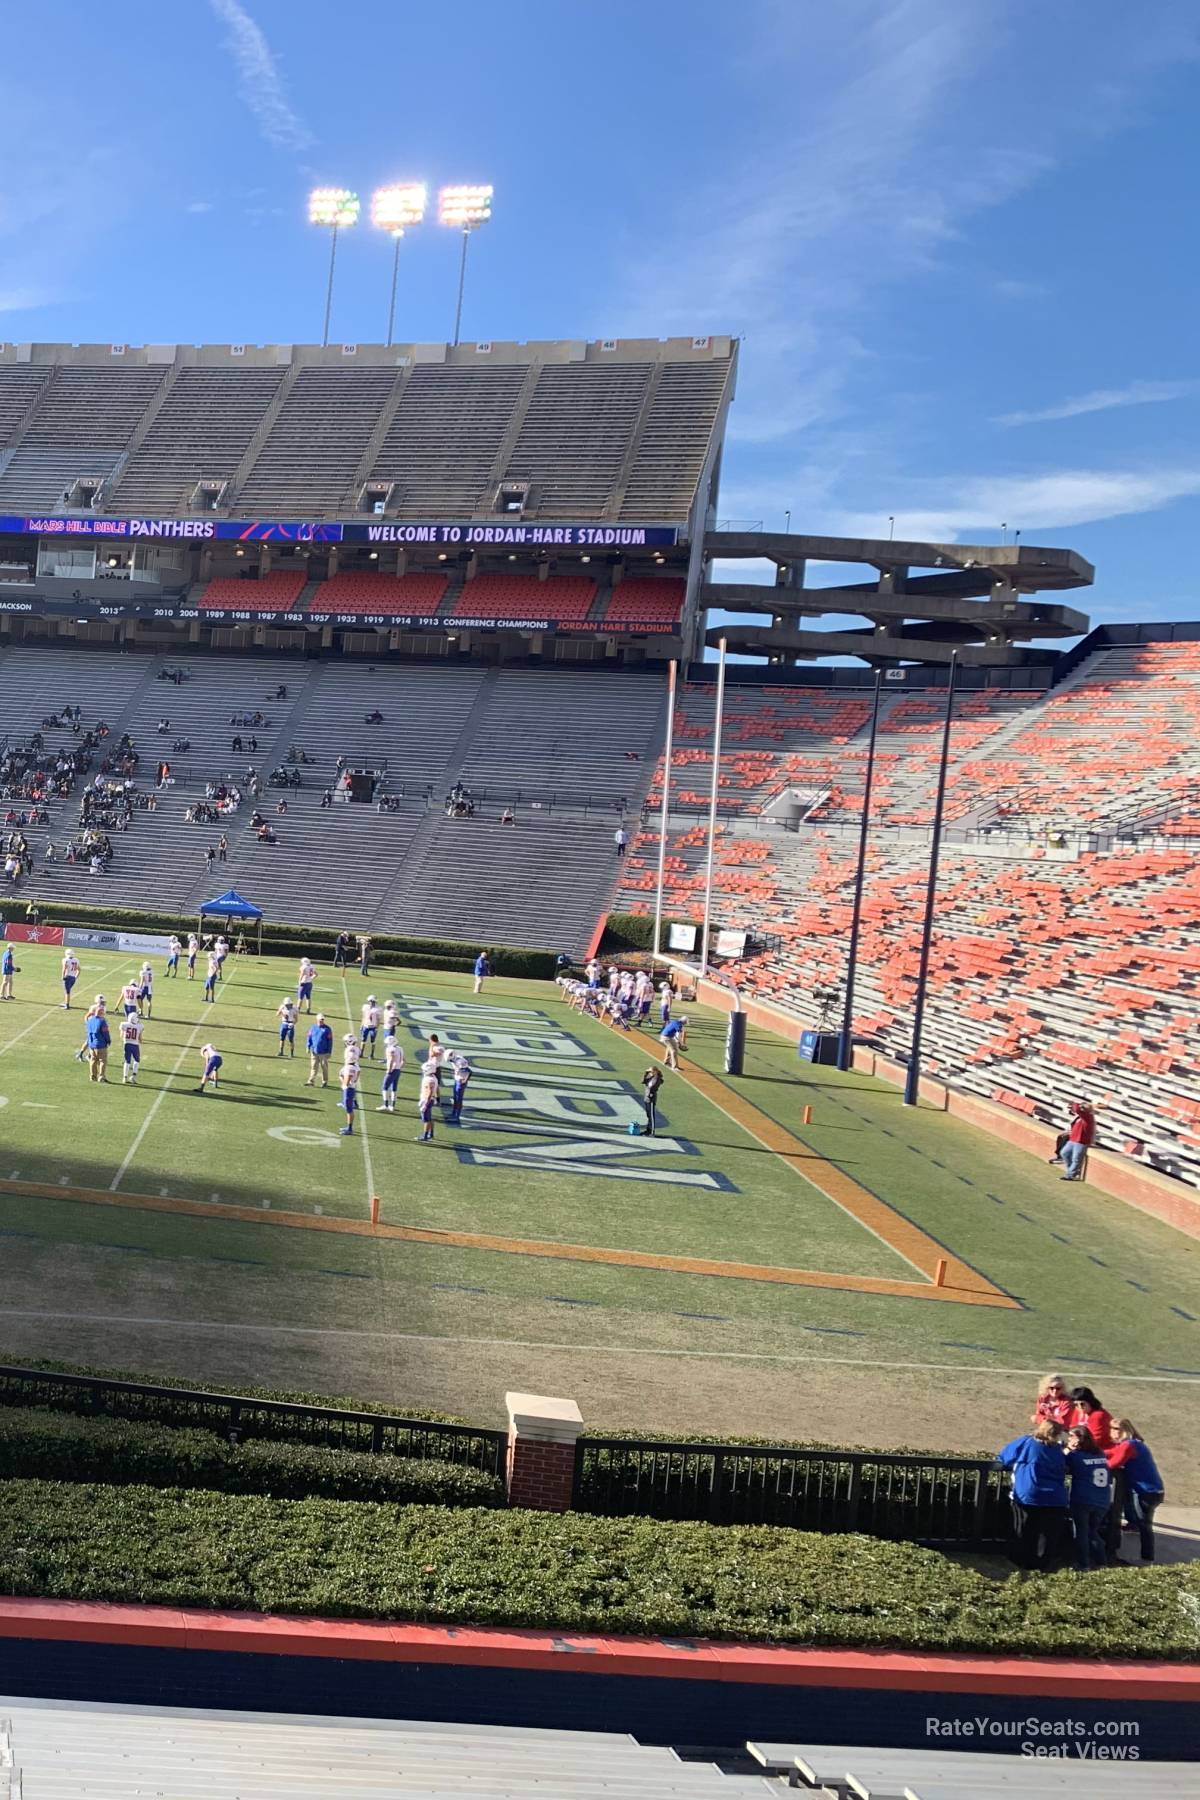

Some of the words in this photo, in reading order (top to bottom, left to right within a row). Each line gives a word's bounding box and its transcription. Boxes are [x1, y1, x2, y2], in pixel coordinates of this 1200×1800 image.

[29, 519, 64, 531] MARS
[66, 520, 92, 532] HILL
[93, 521, 126, 533] BIBLE
[130, 520, 214, 537] PANTHERS
[368, 526, 437, 542] WELCOME
[441, 526, 461, 542] TO
[465, 526, 572, 544] JORDAN-HARE
[577, 528, 646, 544] STADIUM
[100, 606, 119, 615] 2013
[154, 608, 173, 616] 2010
[205, 610, 225, 618] 1989
[231, 611, 250, 619] 1988
[257, 612, 277, 620] 1987
[283, 613, 303, 621] 1983
[310, 614, 330, 622] 1957
[337, 615, 356, 623] 1932
[364, 616, 384, 624] 1919
[391, 617, 411, 625] 1914
[419, 617, 439, 625] 1913
[443, 618, 495, 627] CONFERENCE
[497, 620, 549, 629] CHAMPIONS
[556, 621, 598, 631] JORDAN
[600, 623, 625, 632] HARE
[629, 623, 673, 632] STADIUM
[126, 1027, 137, 1040] 50
[266, 1126, 341, 1148] G
[1093, 1468, 1108, 1487] 8
